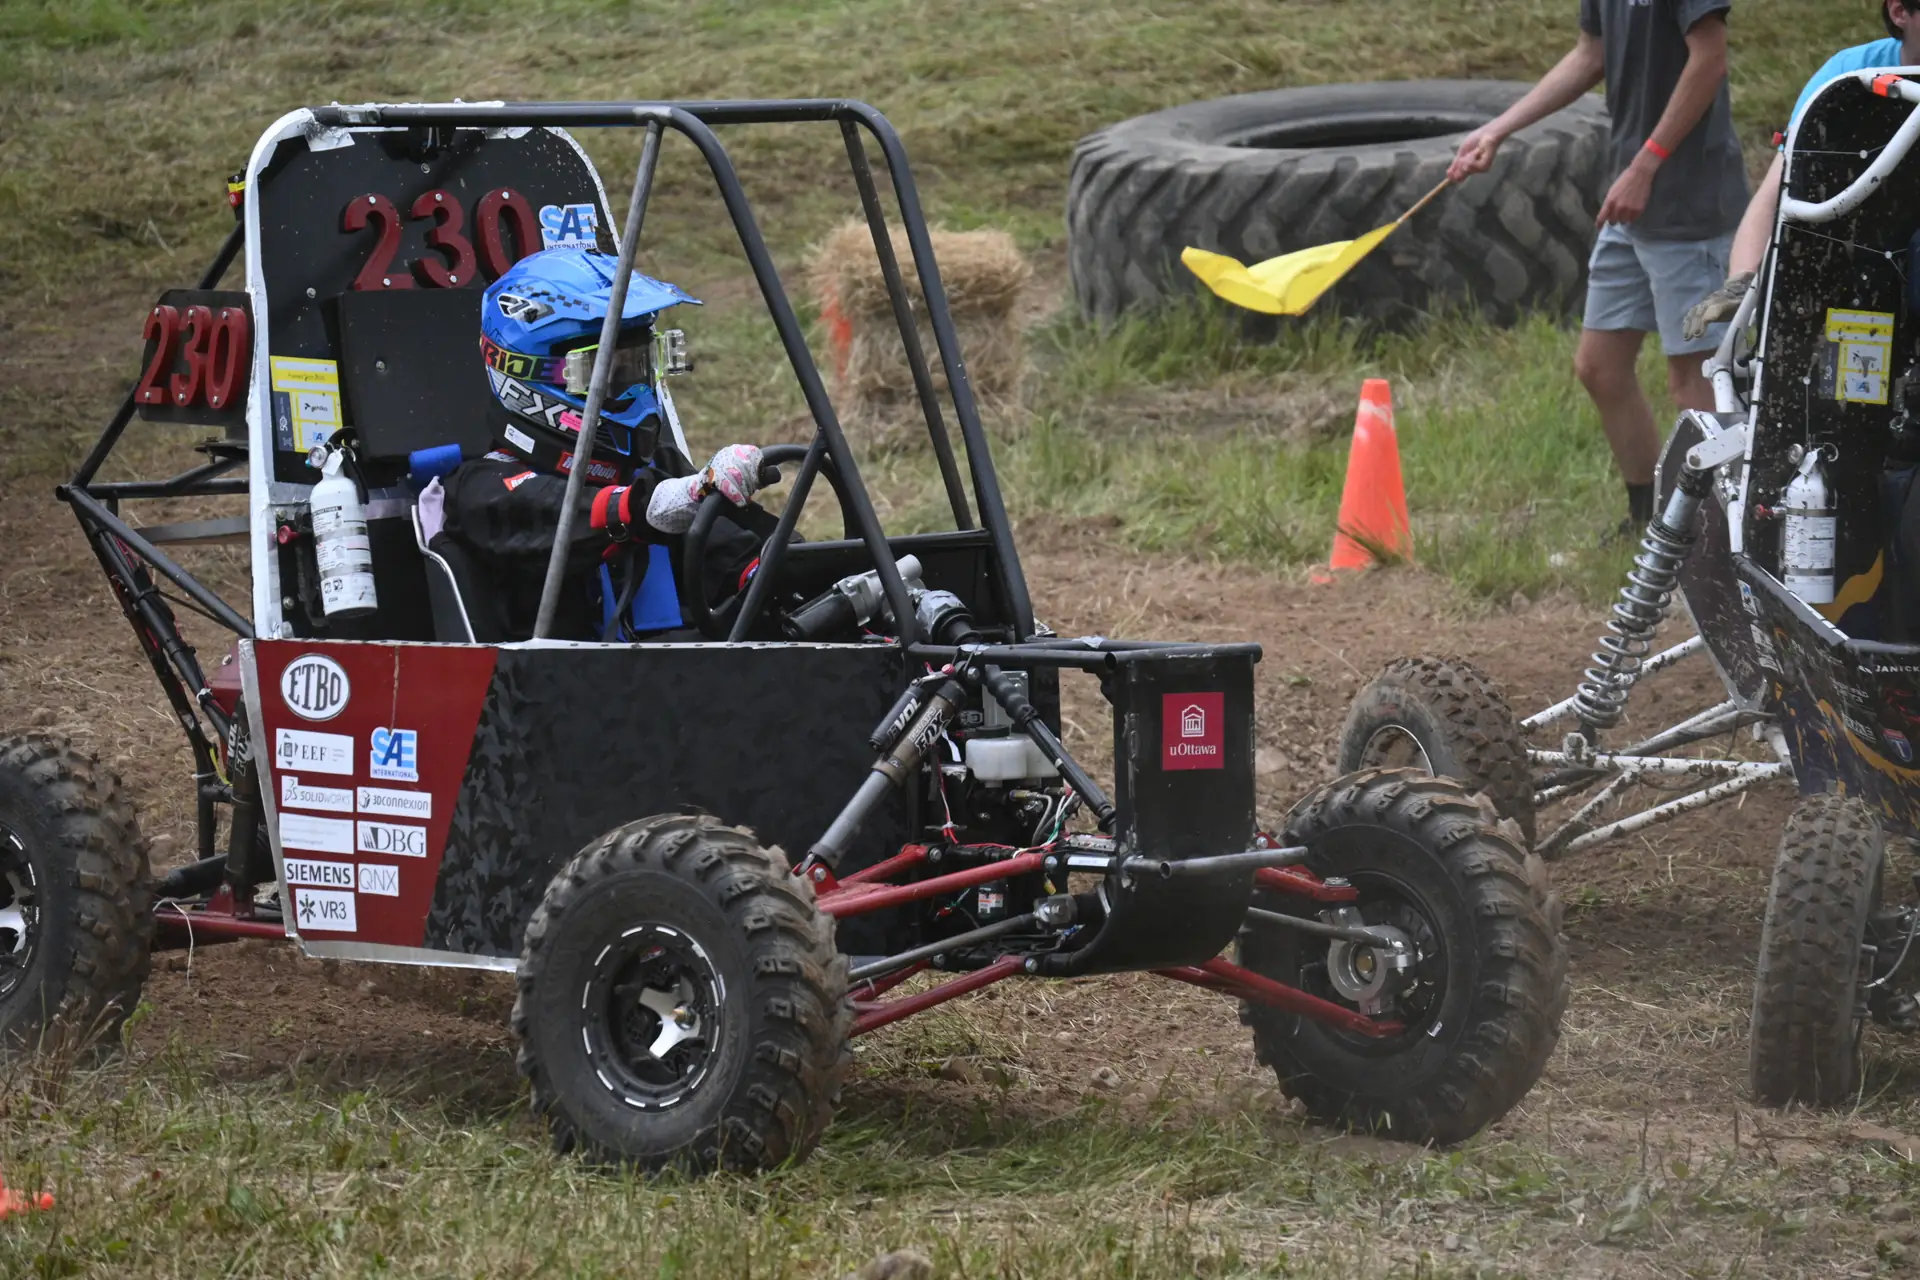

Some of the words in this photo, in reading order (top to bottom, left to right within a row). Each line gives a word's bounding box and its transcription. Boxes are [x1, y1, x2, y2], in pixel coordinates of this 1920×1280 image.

[540, 206, 596, 241] SAE
[344, 187, 540, 290] 230
[134, 305, 247, 408] 230
[287, 660, 341, 712] ETBO
[301, 744, 327, 762] EEF
[371, 729, 415, 768] SAE
[1169, 743, 1216, 756] uOttawa
[299, 789, 351, 806] SOLIDWORKS
[376, 826, 425, 855] DBG
[286, 862, 351, 885] SIEMENS
[359, 868, 398, 892] QNX
[319, 900, 347, 920] VR3
